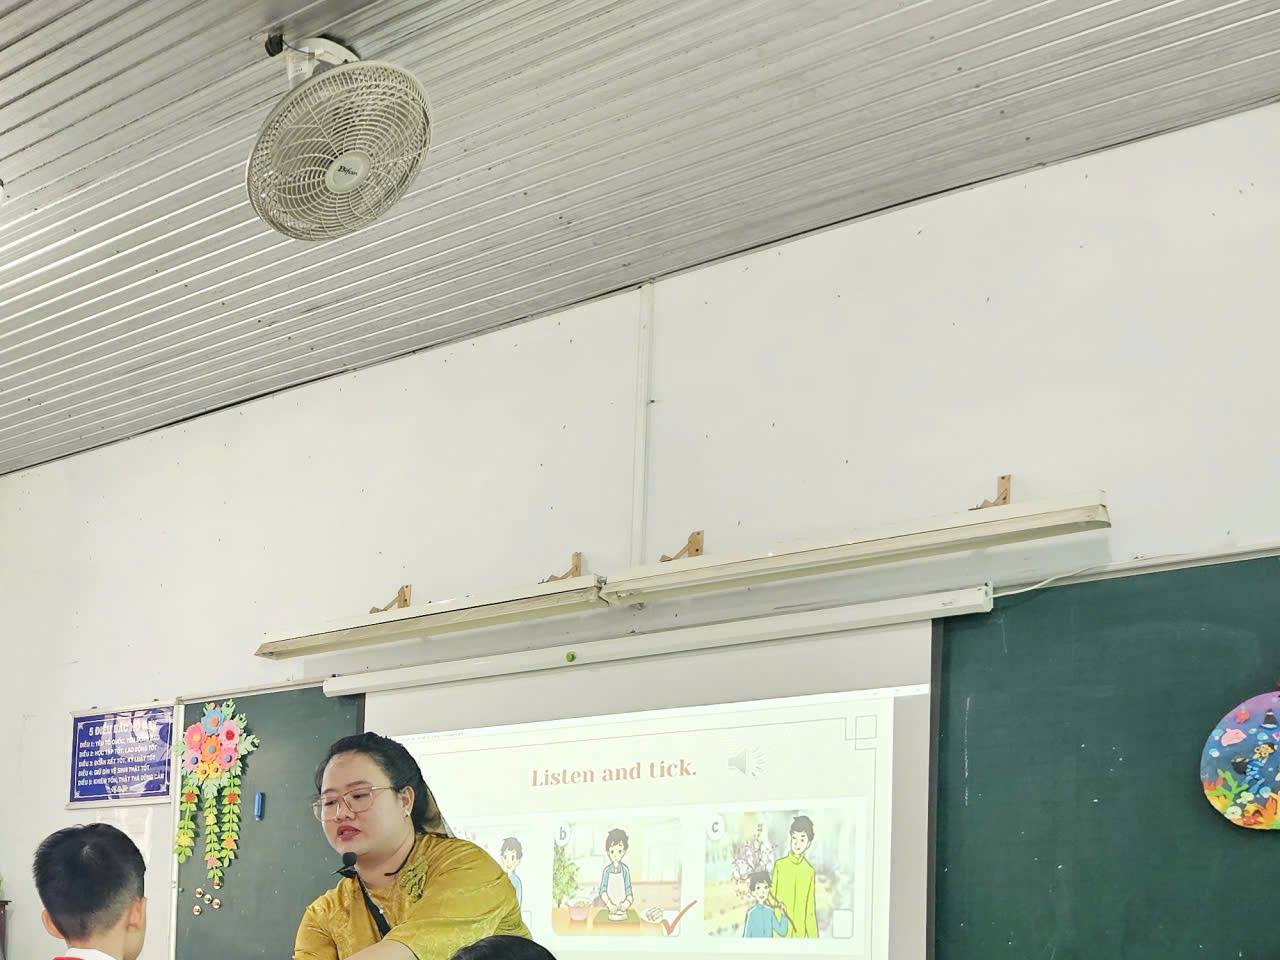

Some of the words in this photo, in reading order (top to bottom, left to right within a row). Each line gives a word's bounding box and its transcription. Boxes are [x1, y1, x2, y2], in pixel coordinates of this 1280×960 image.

[88, 726, 94, 737] 5
[531, 768, 595, 787] Listen
[601, 761, 641, 782] and
[649, 759, 697, 779] tick.
[559, 826, 567, 841] b
[711, 821, 719, 833] c
